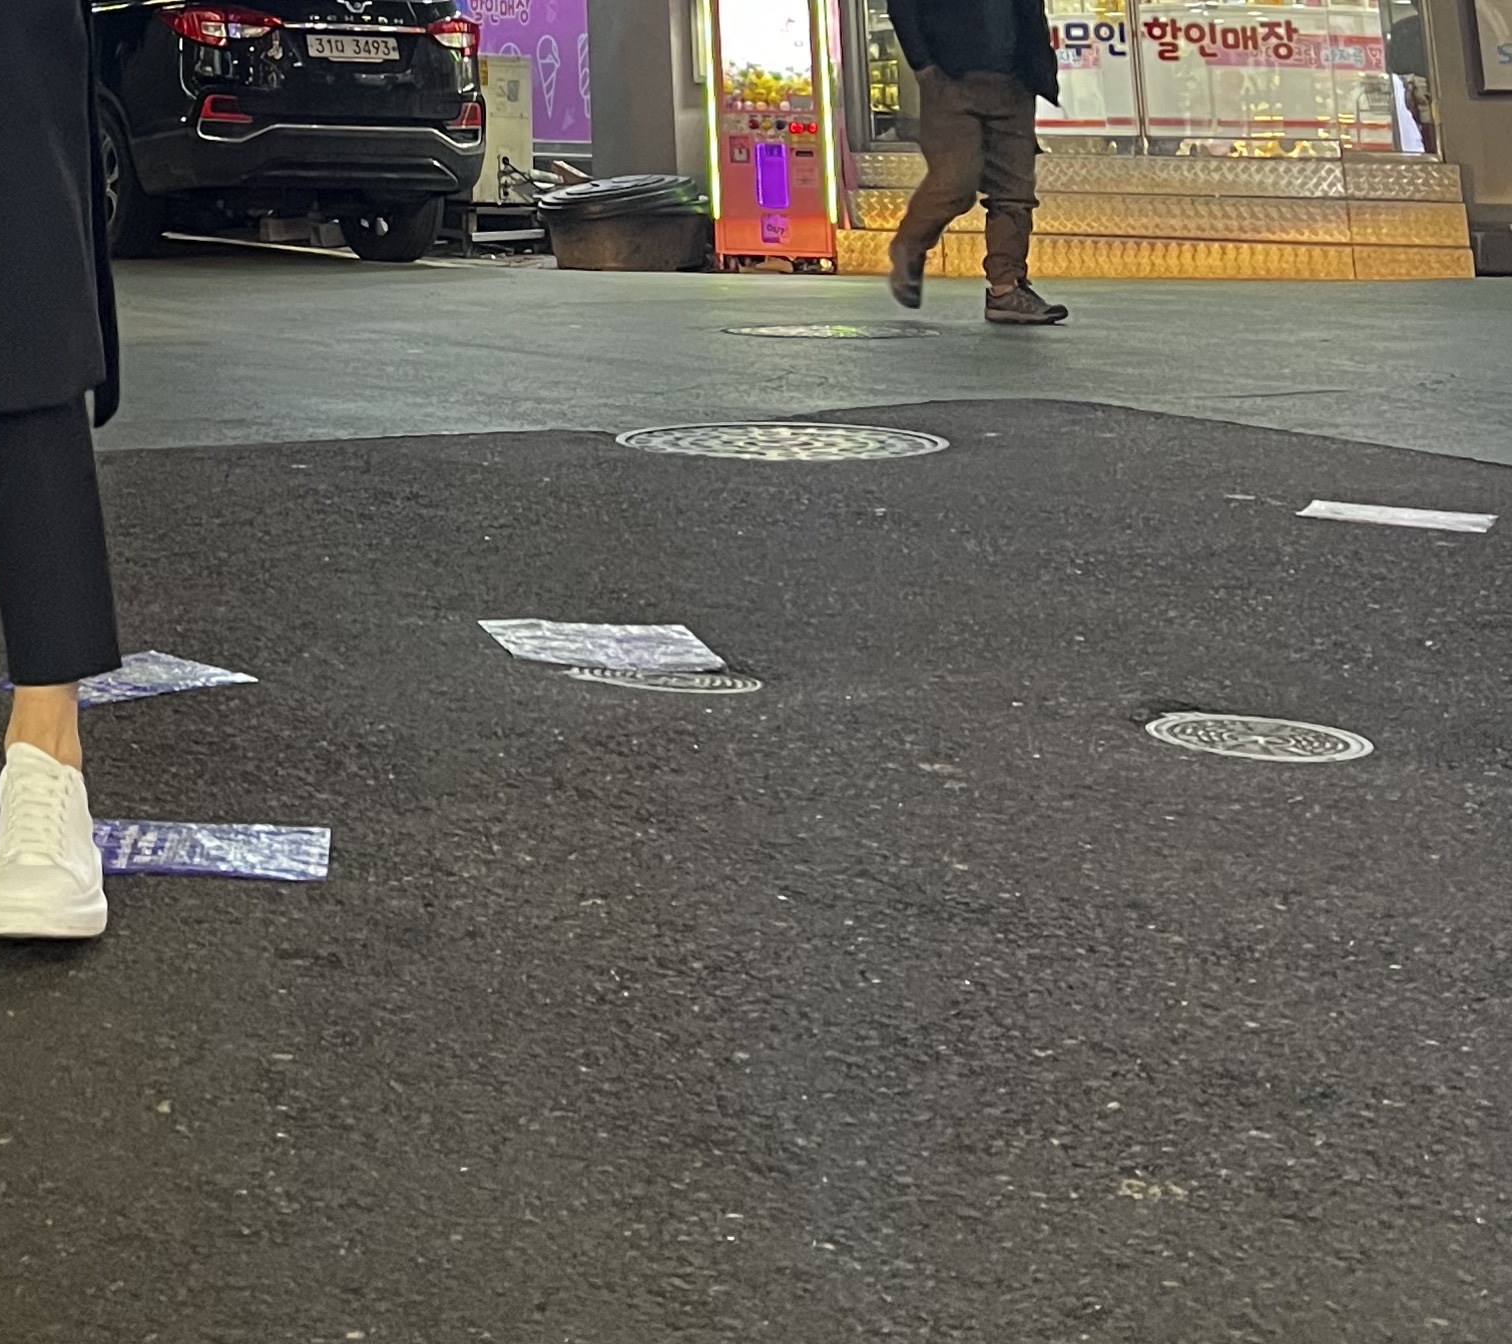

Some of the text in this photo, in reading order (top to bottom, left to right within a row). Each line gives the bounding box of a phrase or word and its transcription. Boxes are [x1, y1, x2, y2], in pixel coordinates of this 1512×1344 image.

[351, 38, 391, 56] 3493
[1063, 21, 1127, 58] 무인
[1143, 17, 1299, 62] 할인매장
